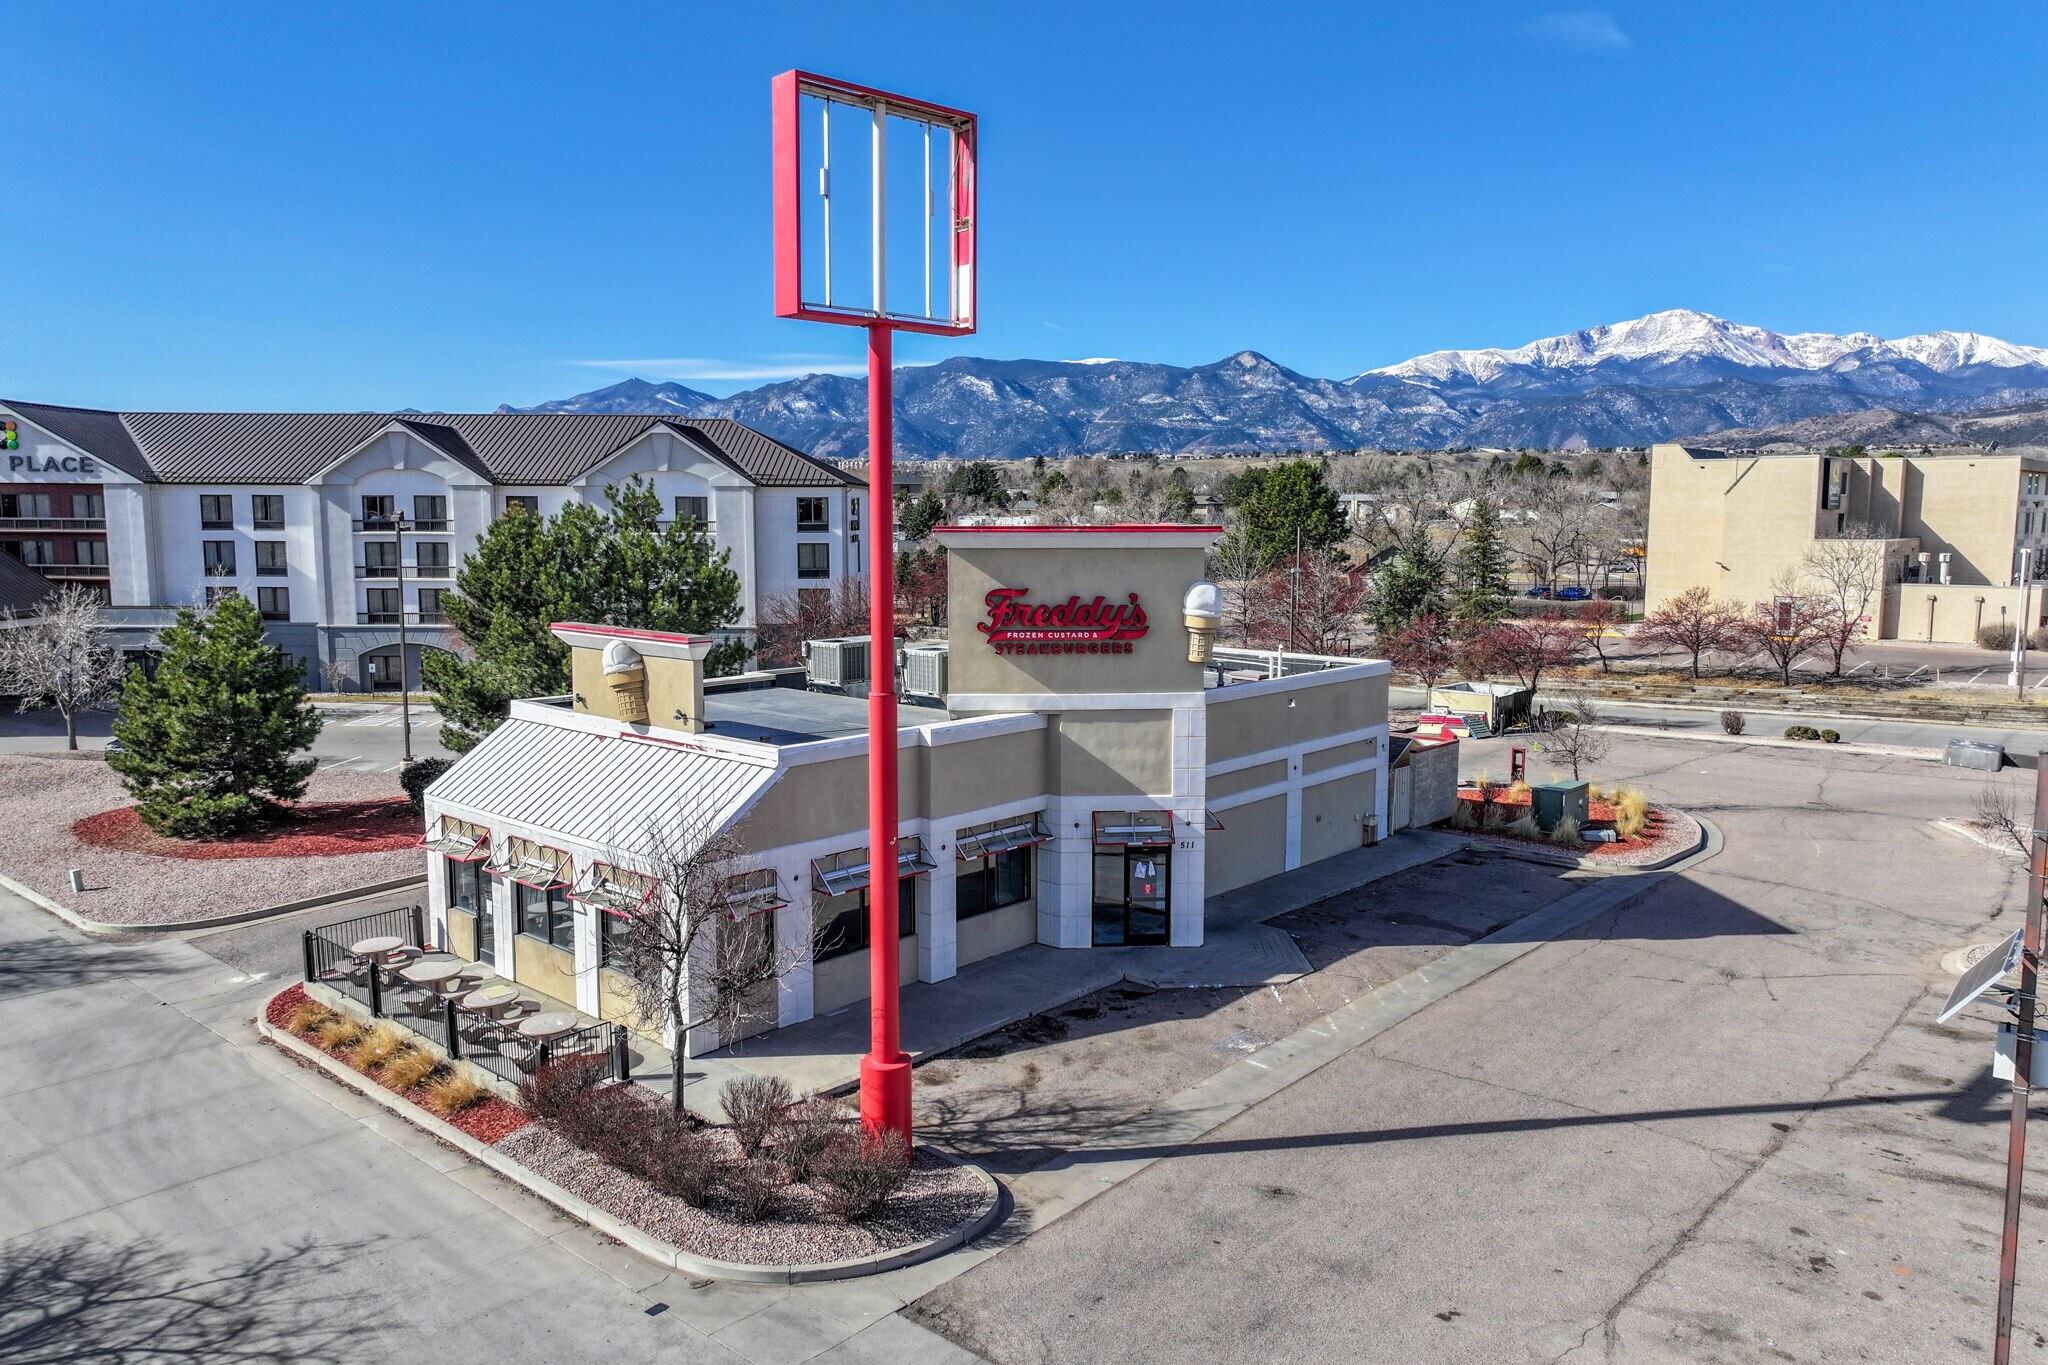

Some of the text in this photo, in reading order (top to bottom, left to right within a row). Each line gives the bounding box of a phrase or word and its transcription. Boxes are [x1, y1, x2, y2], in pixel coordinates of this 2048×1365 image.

[9, 456, 94, 473] PLACE
[977, 588, 1150, 637] Freddy's
[1007, 631, 1044, 639] FROZEN
[1047, 631, 1090, 639] CUSTARD
[995, 642, 1134, 655] STEAKBURGERS
[1180, 841, 1195, 849] 511
